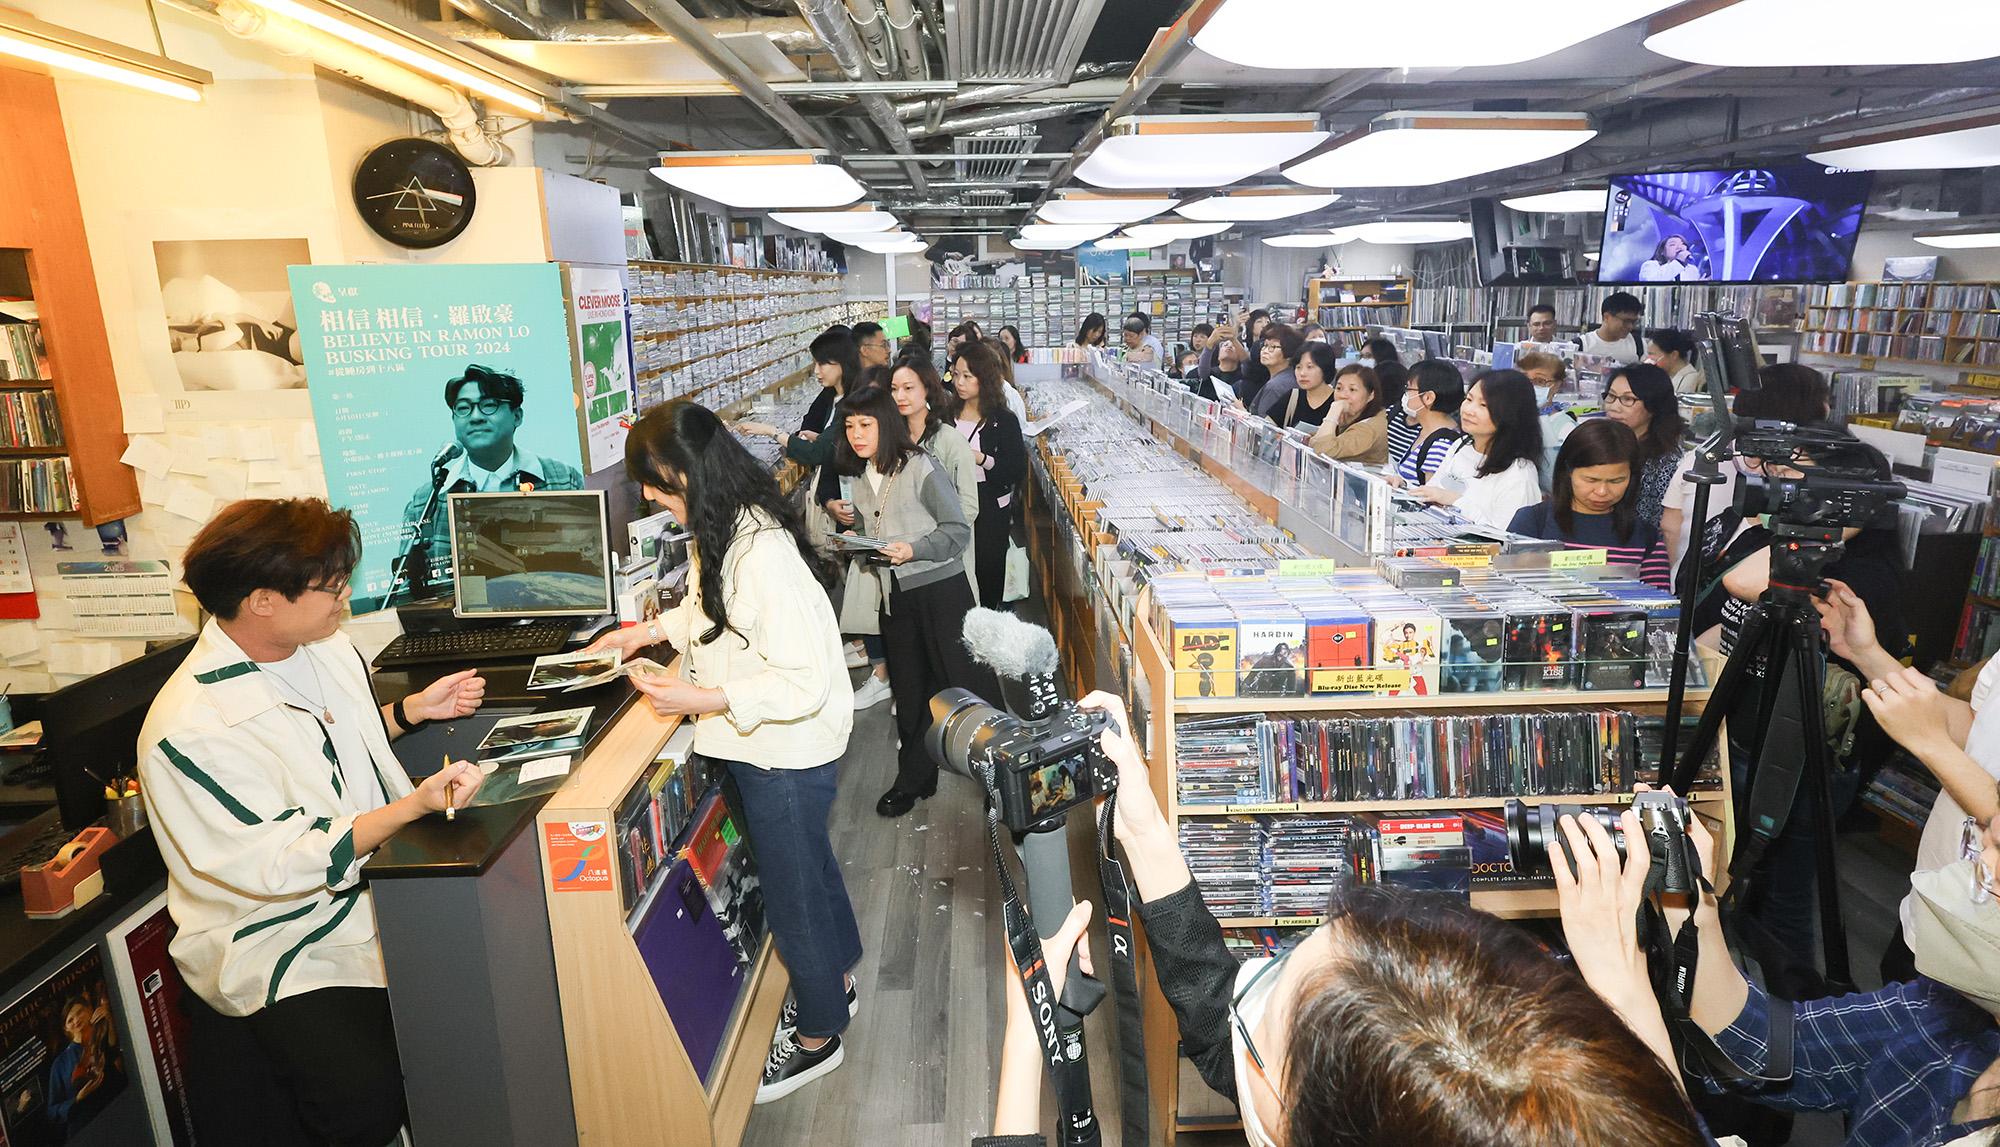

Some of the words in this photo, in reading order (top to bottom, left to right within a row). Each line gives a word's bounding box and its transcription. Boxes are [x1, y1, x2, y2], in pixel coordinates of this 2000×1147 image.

[578, 295, 600, 310] CLEVER
[601, 294, 621, 307] MOOSE
[320, 308, 371, 332] 相信
[376, 306, 423, 330] 相信
[322, 331, 407, 349] BELIEVE
[413, 330, 432, 343] IN
[438, 326, 502, 342] RAMON
[509, 325, 530, 338] LO
[325, 346, 413, 365] BUSKING
[417, 343, 469, 358] TOUR
[475, 341, 512, 355] 2024
[1182, 635, 1229, 651] JADE
[1543, 668, 1564, 676] KISS
[1472, 862, 1514, 874] DOCTO
[1031, 980, 1064, 1066] SONY
